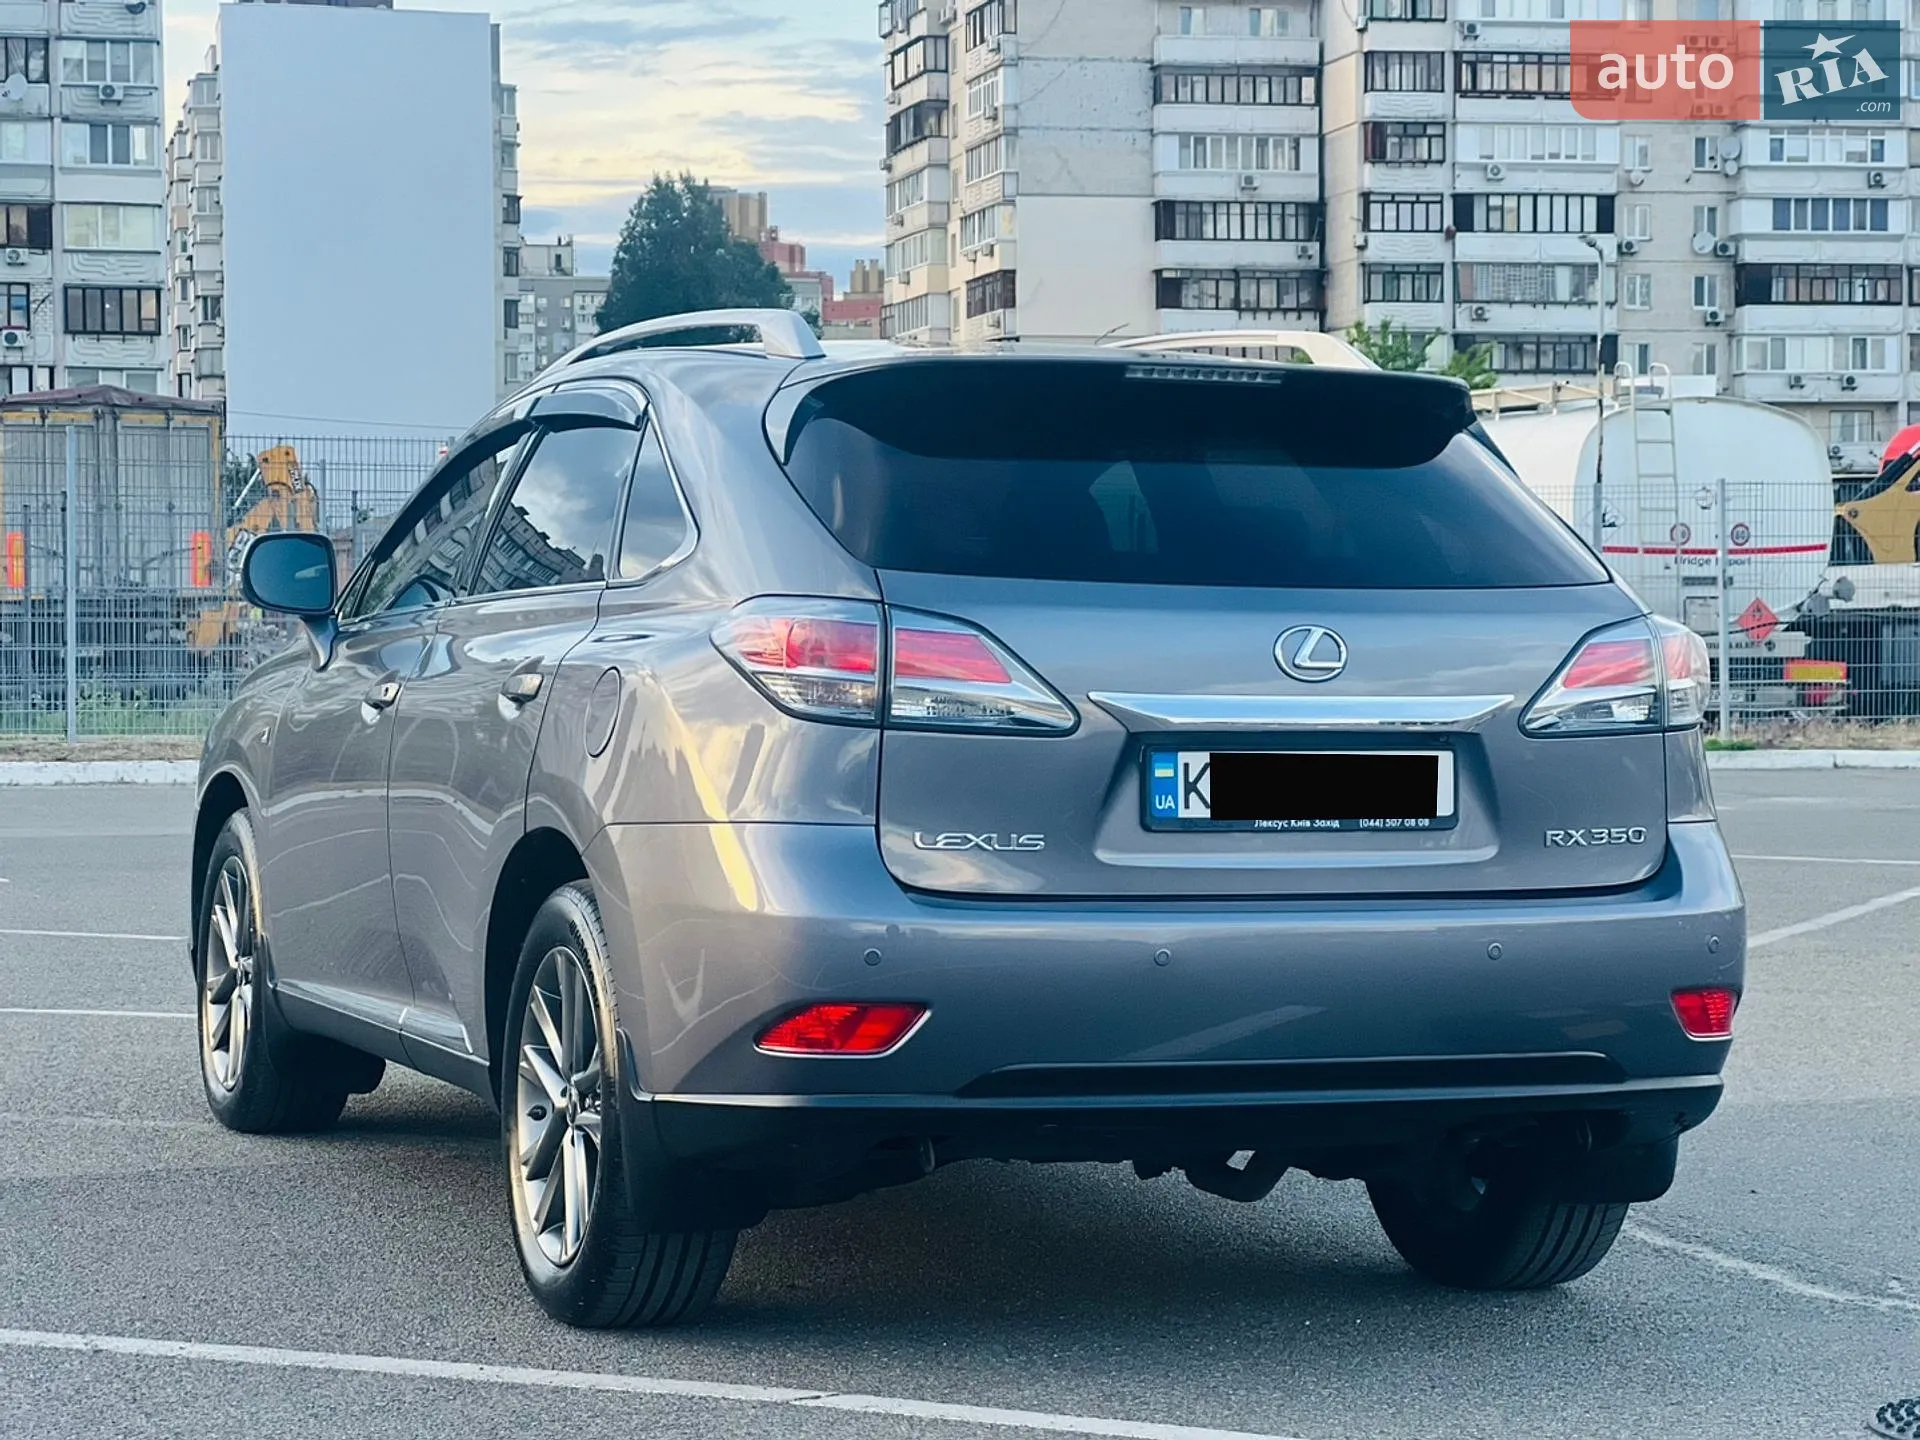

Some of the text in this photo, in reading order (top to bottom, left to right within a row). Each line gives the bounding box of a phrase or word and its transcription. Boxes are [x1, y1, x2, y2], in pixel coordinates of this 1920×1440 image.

[1155, 794, 1175, 809] UA
[1385, 818, 1402, 827] 507
[913, 832, 1046, 851] LEXUS
